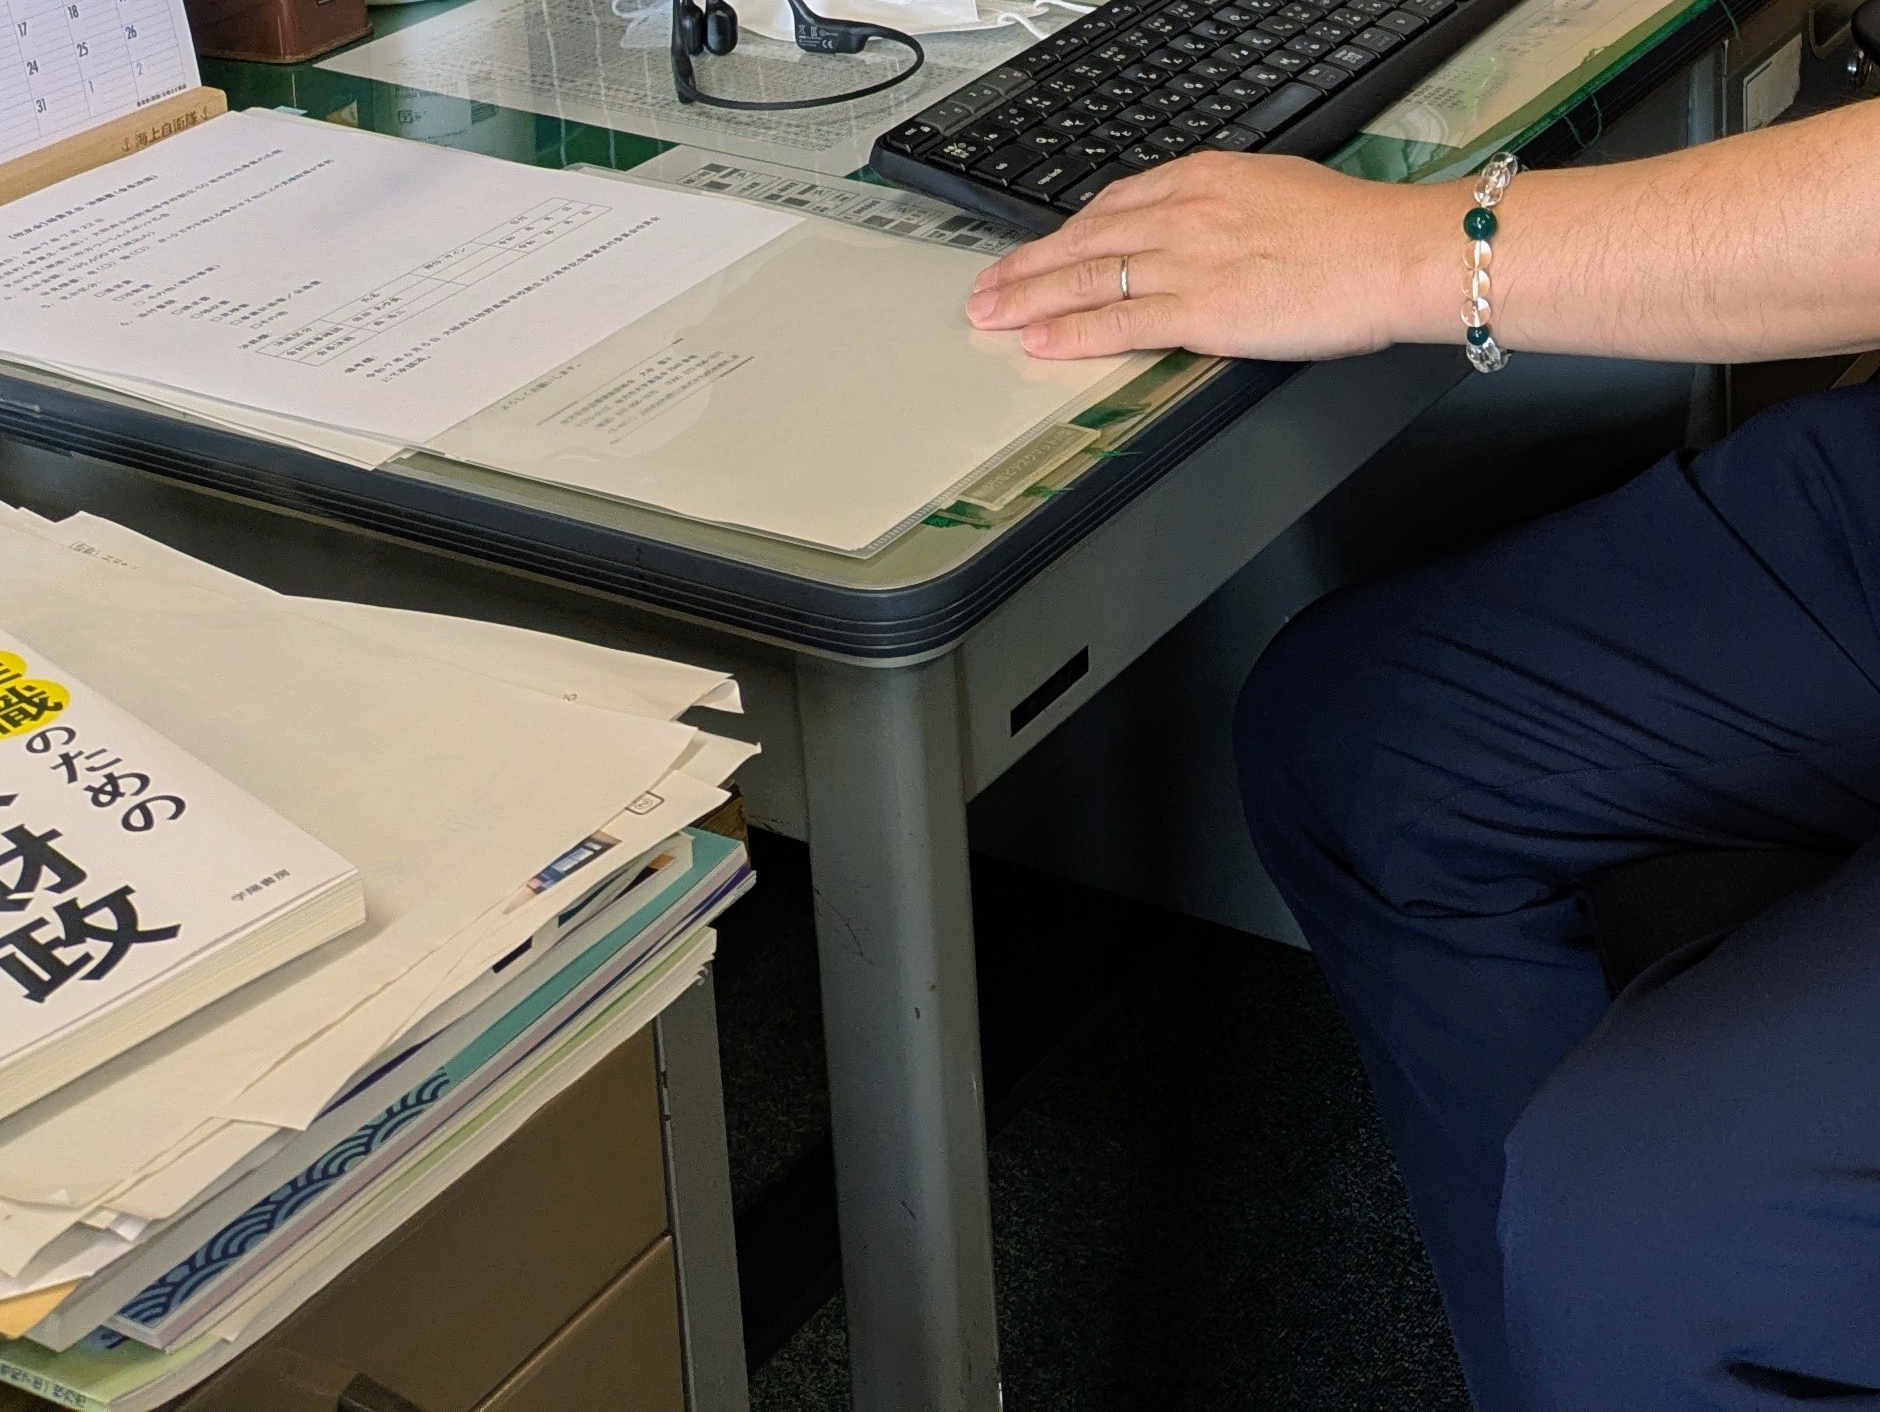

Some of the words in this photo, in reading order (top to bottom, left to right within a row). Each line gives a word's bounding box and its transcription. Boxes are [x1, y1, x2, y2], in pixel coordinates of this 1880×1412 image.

[17, 22, 27, 36] 17
[68, 5, 79, 19] 18
[26, 60, 38, 75] 24
[76, 42, 89, 57] 25
[125, 25, 137, 39] 26
[36, 98, 47, 113] 31
[136, 63, 143, 76] 2
[136, 111, 198, 147] 海上自衛隊
[232, 868, 290, 902] 学陽書房
